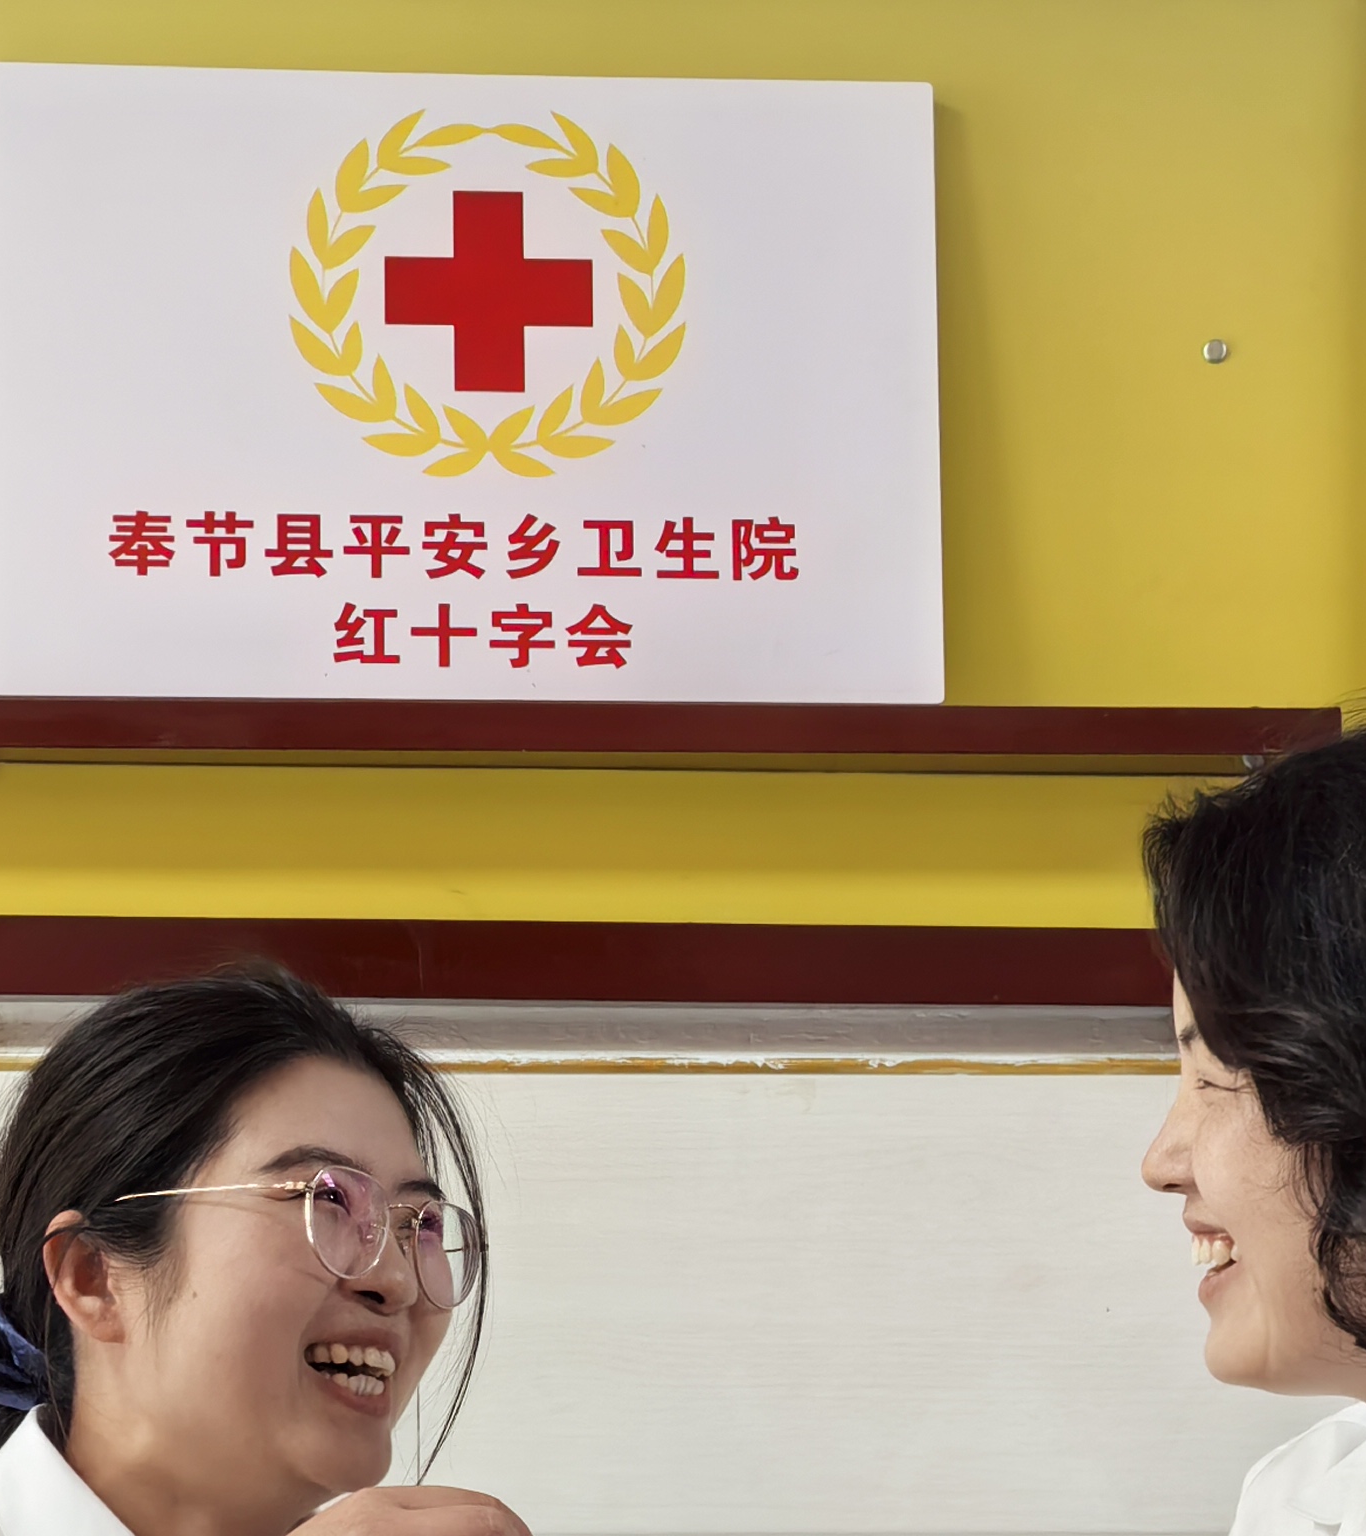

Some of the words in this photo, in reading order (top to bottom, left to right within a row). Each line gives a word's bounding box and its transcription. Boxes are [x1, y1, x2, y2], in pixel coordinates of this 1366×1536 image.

[107, 511, 800, 582] 奉节县平安乡卫生院
[332, 602, 635, 669] 红十字会
